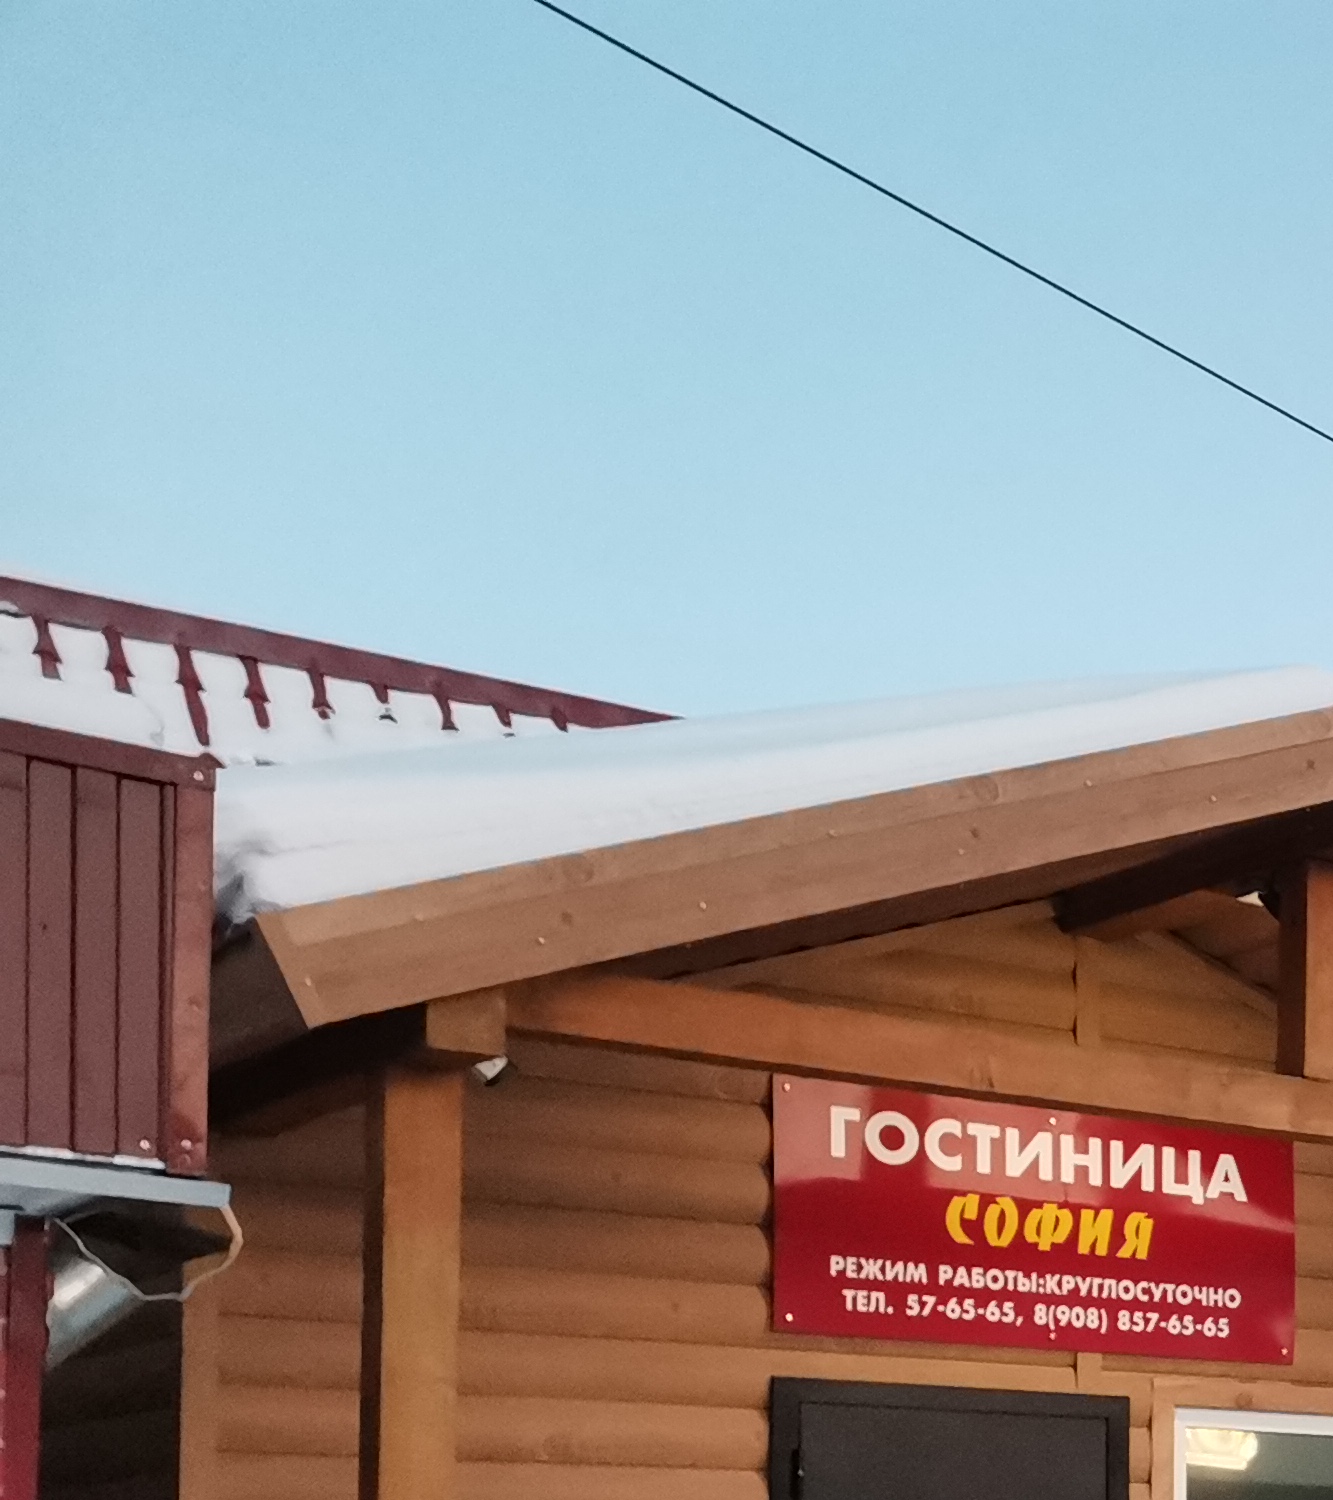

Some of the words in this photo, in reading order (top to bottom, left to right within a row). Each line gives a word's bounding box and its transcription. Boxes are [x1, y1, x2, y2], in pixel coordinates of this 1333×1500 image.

[829, 1105, 1249, 1205] ГОСТИНИЦА
[944, 1193, 1155, 1260] СОФИЯ
[829, 1254, 928, 1285] РЕЖИМ
[842, 1288, 894, 1315] ТЕЛ.
[905, 1294, 1024, 1327] 57-65-65,
[1033, 1303, 1108, 1334] 8(908)
[1117, 1309, 1230, 1338] 857-65-65
